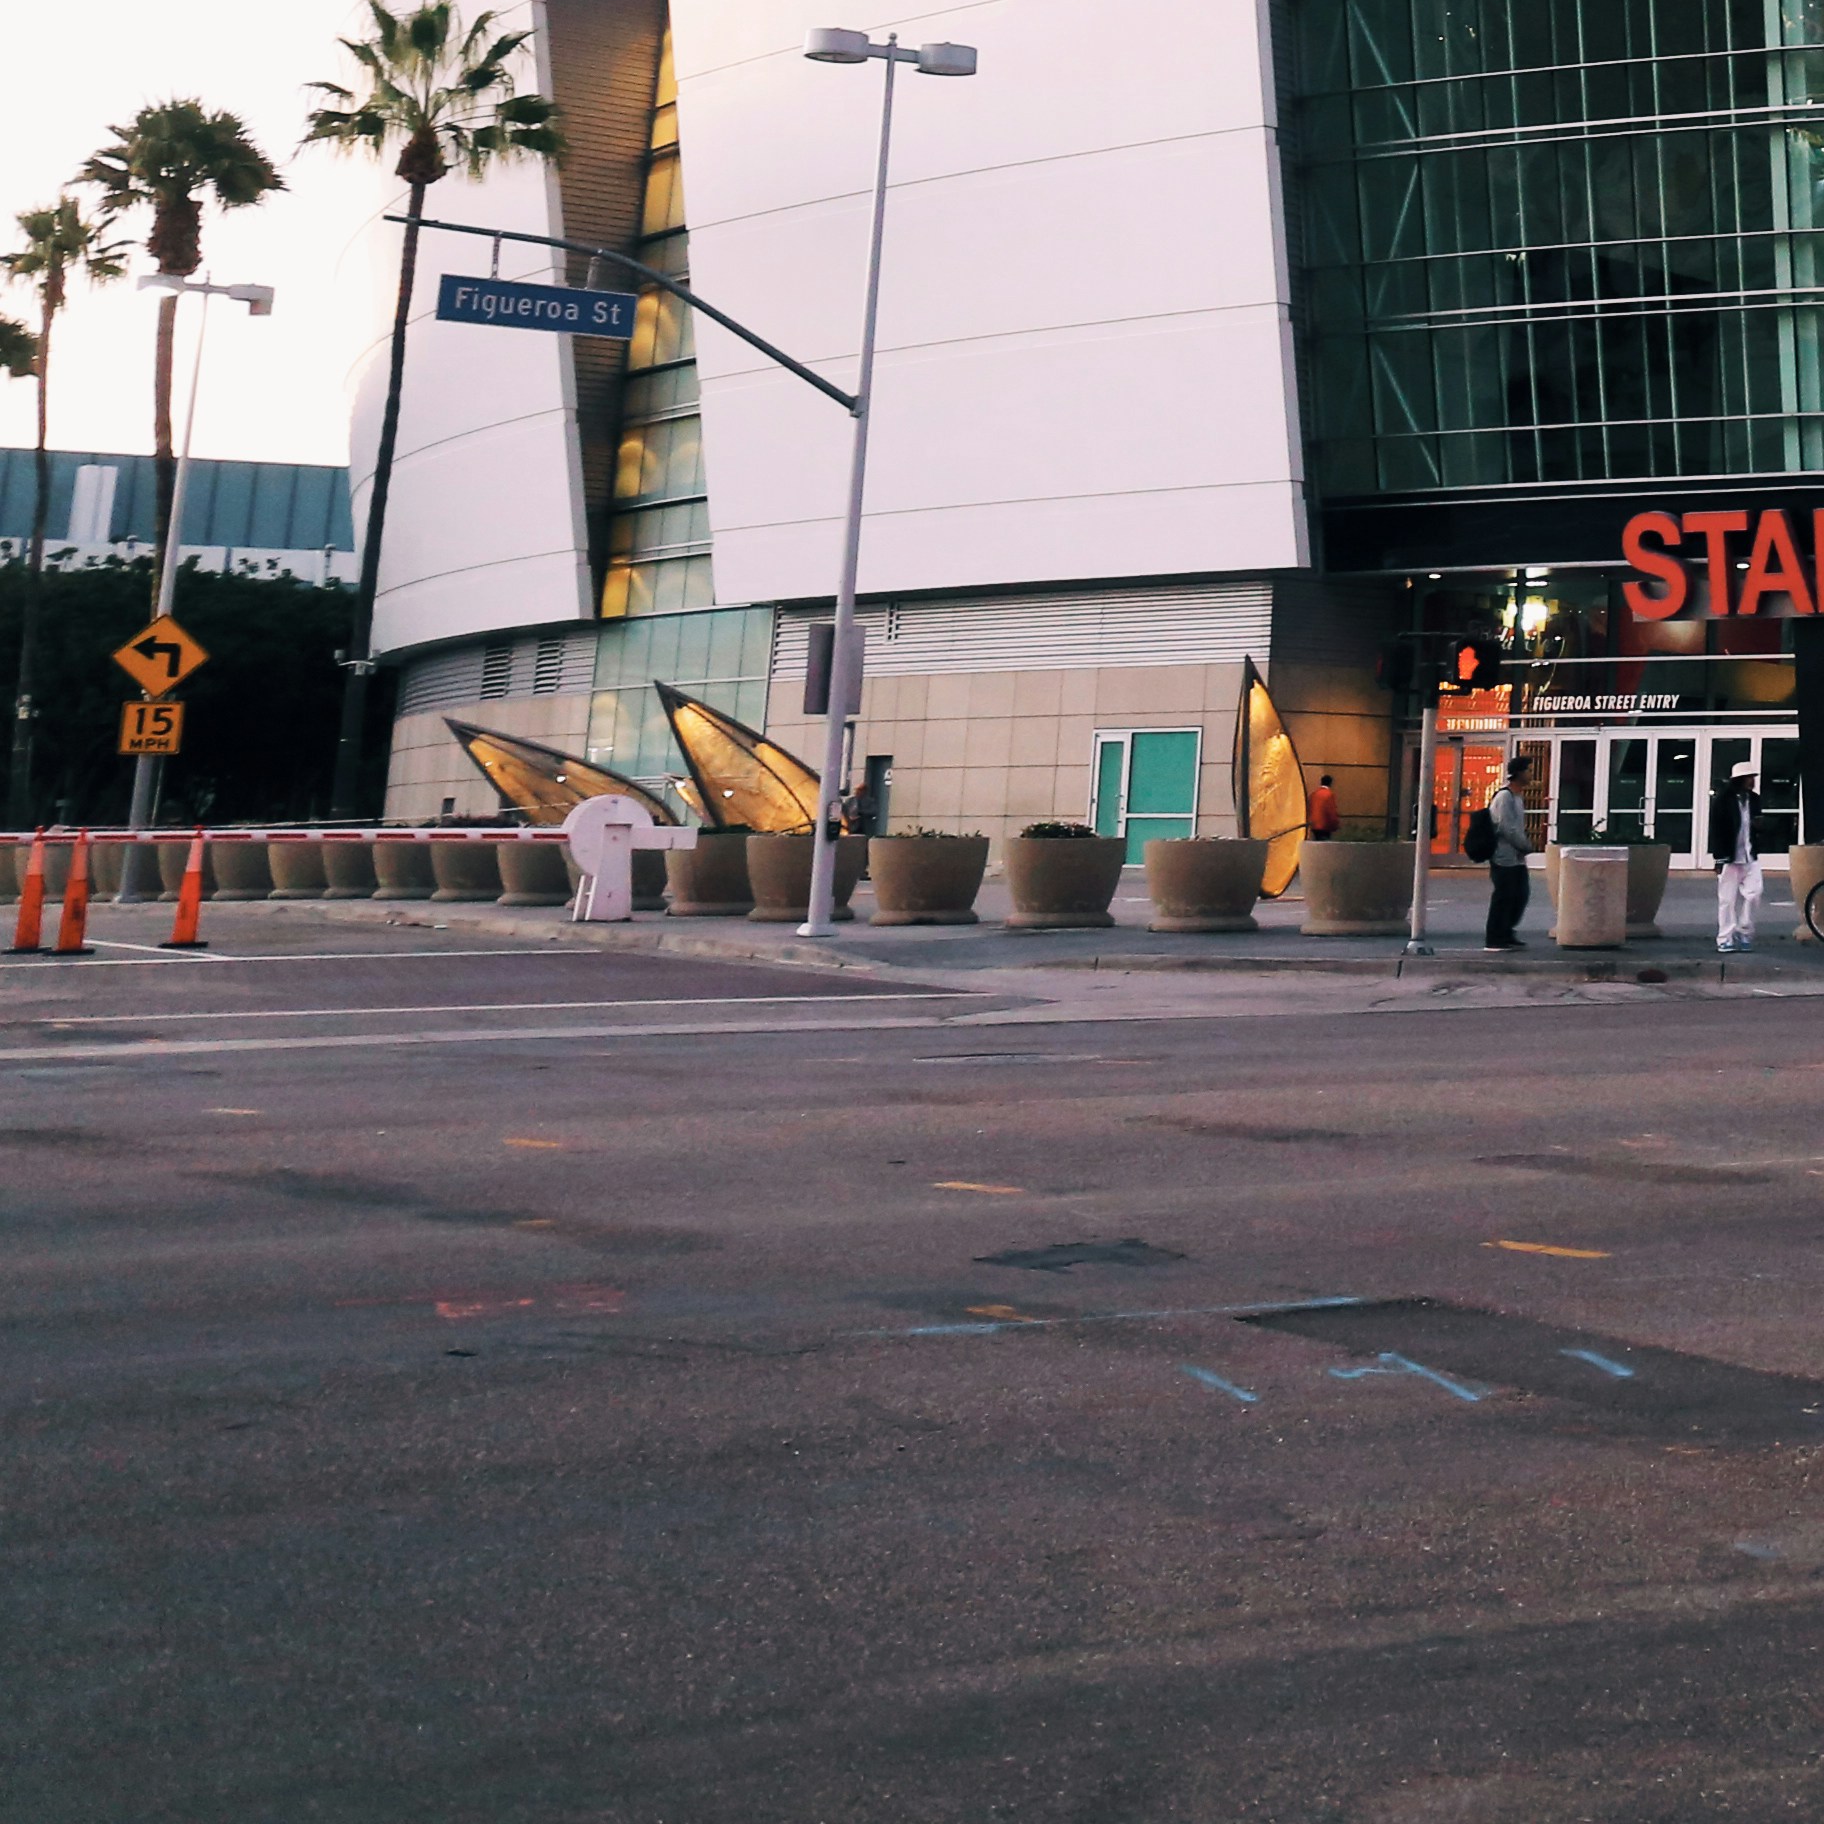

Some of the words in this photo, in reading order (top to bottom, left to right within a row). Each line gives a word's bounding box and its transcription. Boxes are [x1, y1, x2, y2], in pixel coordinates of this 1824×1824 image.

[454, 286, 579, 320] Figueroa
[591, 301, 621, 325] St
[1533, 695, 1591, 711] FIGUEROA
[1595, 695, 1637, 710] STREET
[1640, 694, 1680, 709] ENTRY
[136, 707, 174, 735] 15
[129, 738, 170, 750] MPH
